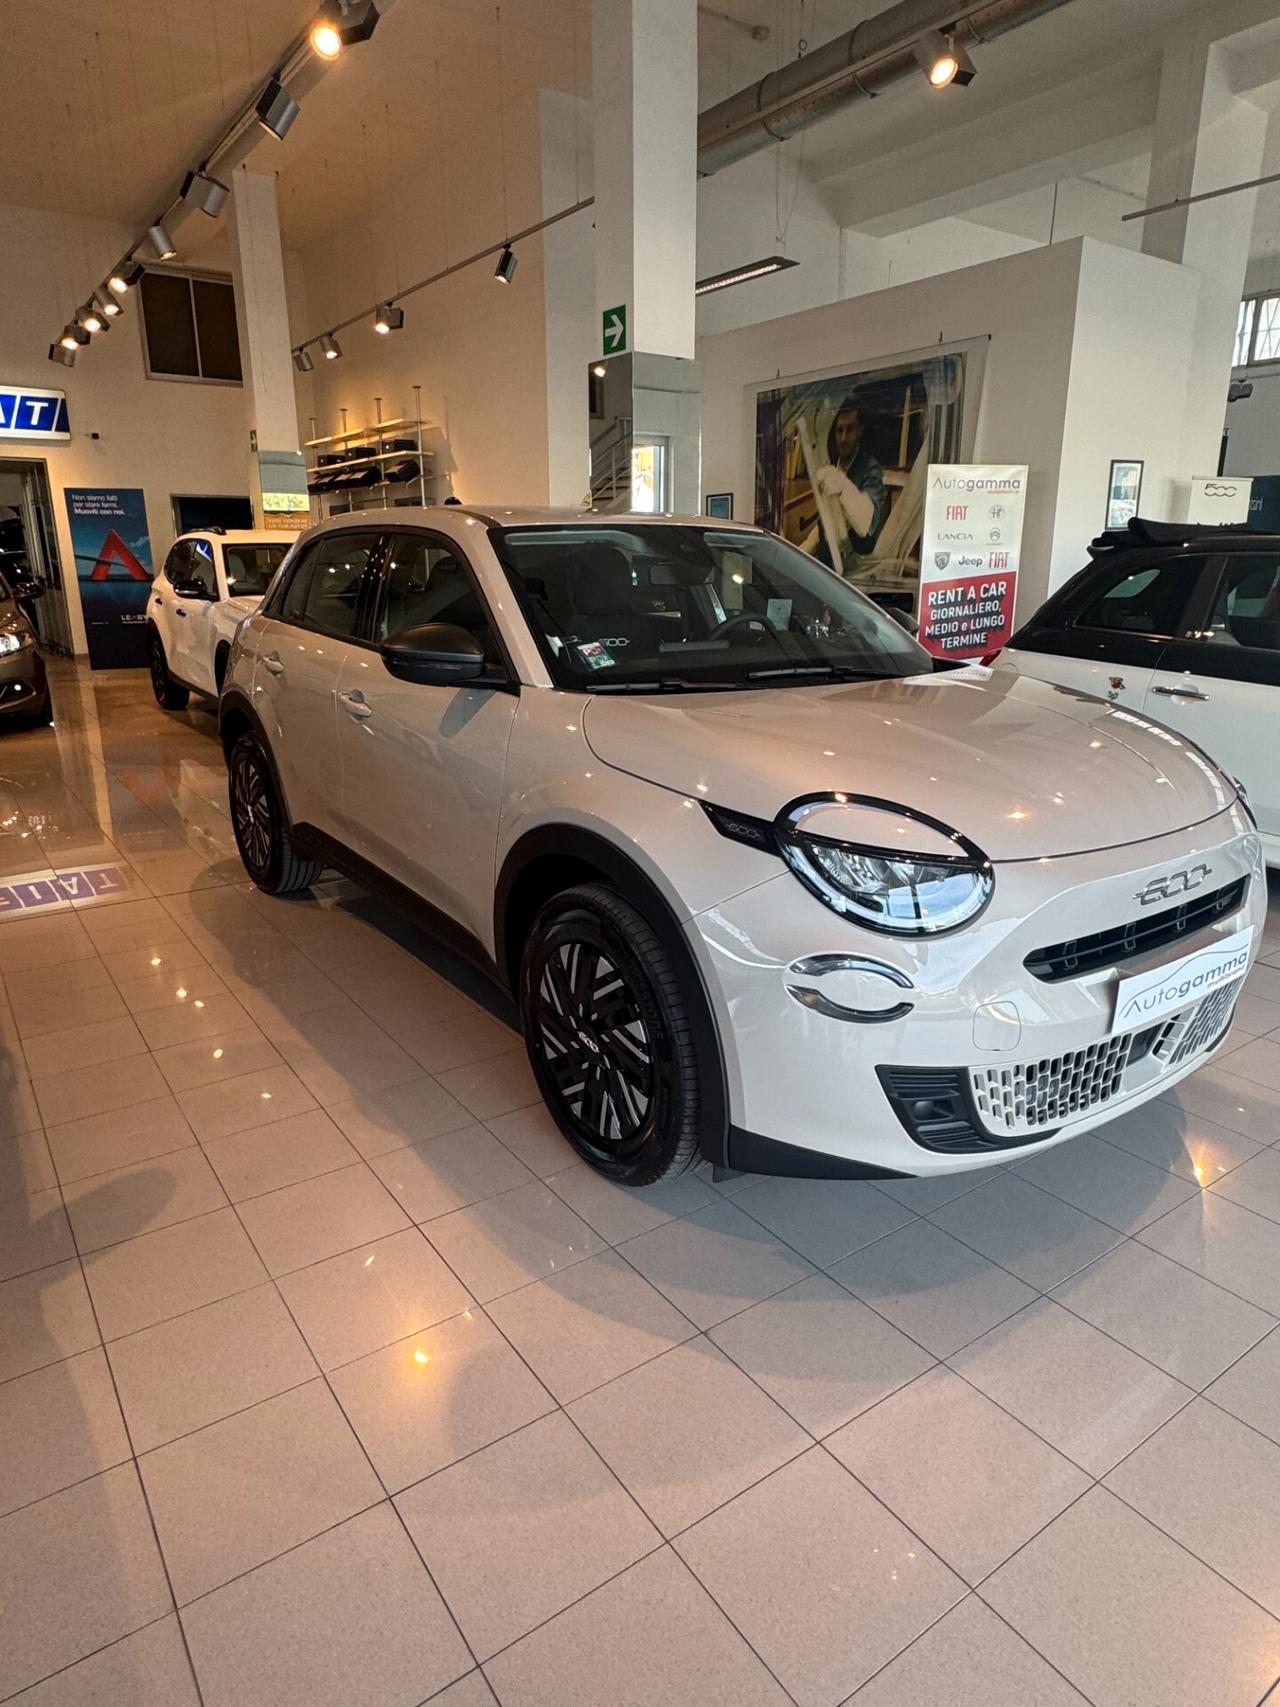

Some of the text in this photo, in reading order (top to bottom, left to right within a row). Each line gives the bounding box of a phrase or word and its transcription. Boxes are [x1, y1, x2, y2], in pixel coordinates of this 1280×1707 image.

[933, 478, 1020, 492] Autogamma
[1204, 483, 1237, 497] 500
[946, 505, 969, 520] FIAT
[937, 533, 974, 541] LANCIA
[958, 552, 1010, 568] Jeep FIAT
[928, 581, 1007, 606] RENT A CAR
[925, 614, 1005, 637] MEDIO e LUNGO
[941, 632, 988, 649] TERMINE
[1132, 863, 1213, 906] 600
[1123, 951, 1248, 1018] Autogamma
